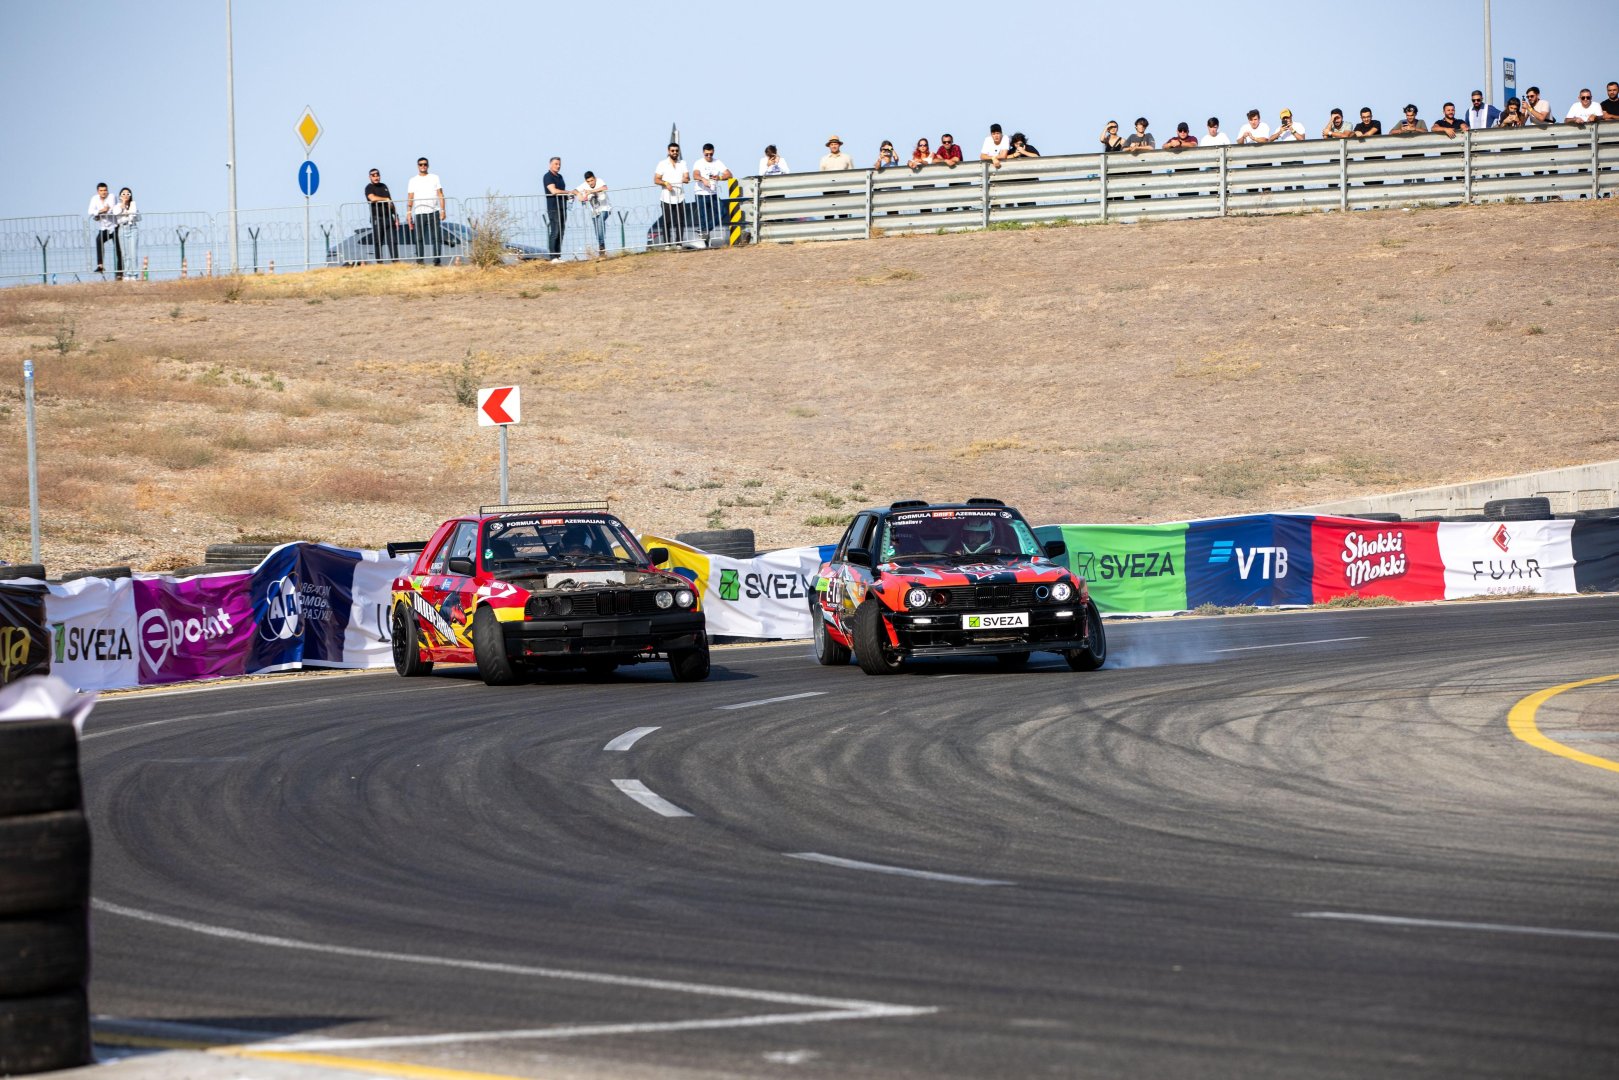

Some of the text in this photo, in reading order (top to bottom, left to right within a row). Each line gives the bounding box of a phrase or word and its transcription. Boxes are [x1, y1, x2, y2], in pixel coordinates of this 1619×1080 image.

[506, 519, 541, 528] FORMULA
[897, 513, 931, 521] FORMULA
[1341, 531, 1403, 563] Shokki
[1100, 551, 1175, 580] SVEZA
[1235, 546, 1288, 580] VTB
[1346, 553, 1406, 587] Mokki
[1472, 559, 1542, 581] FUAR
[983, 616, 1023, 626] SVEZA
[67, 627, 132, 661] SVEZA
